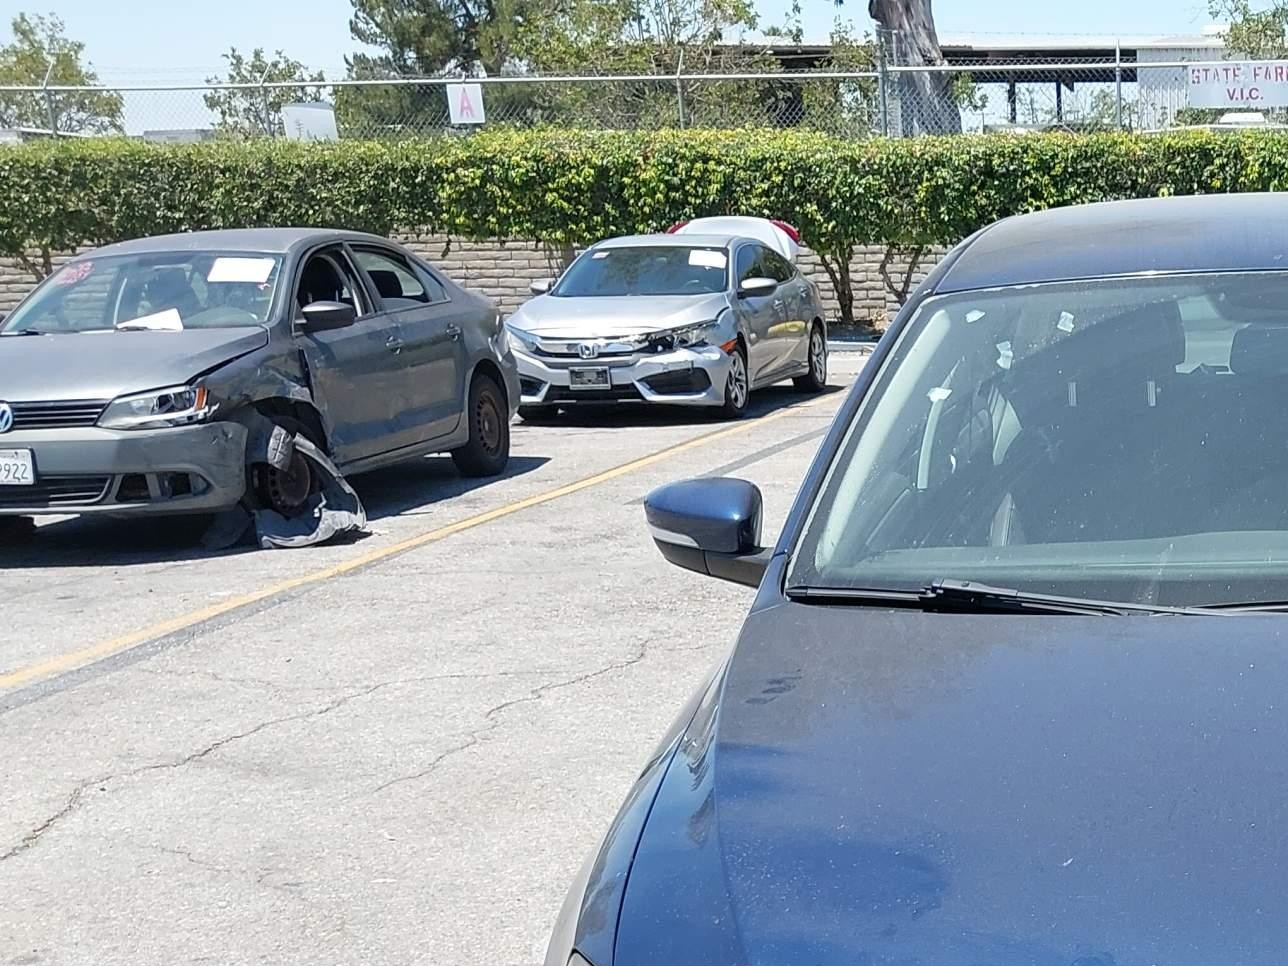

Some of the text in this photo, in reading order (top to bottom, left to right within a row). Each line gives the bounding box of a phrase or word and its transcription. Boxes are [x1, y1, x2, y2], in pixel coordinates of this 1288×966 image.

[1191, 65, 1242, 84] STATE
[460, 86, 474, 118] A
[1226, 87, 1264, 101] V.I.C.
[0, 463, 28, 481] 922
